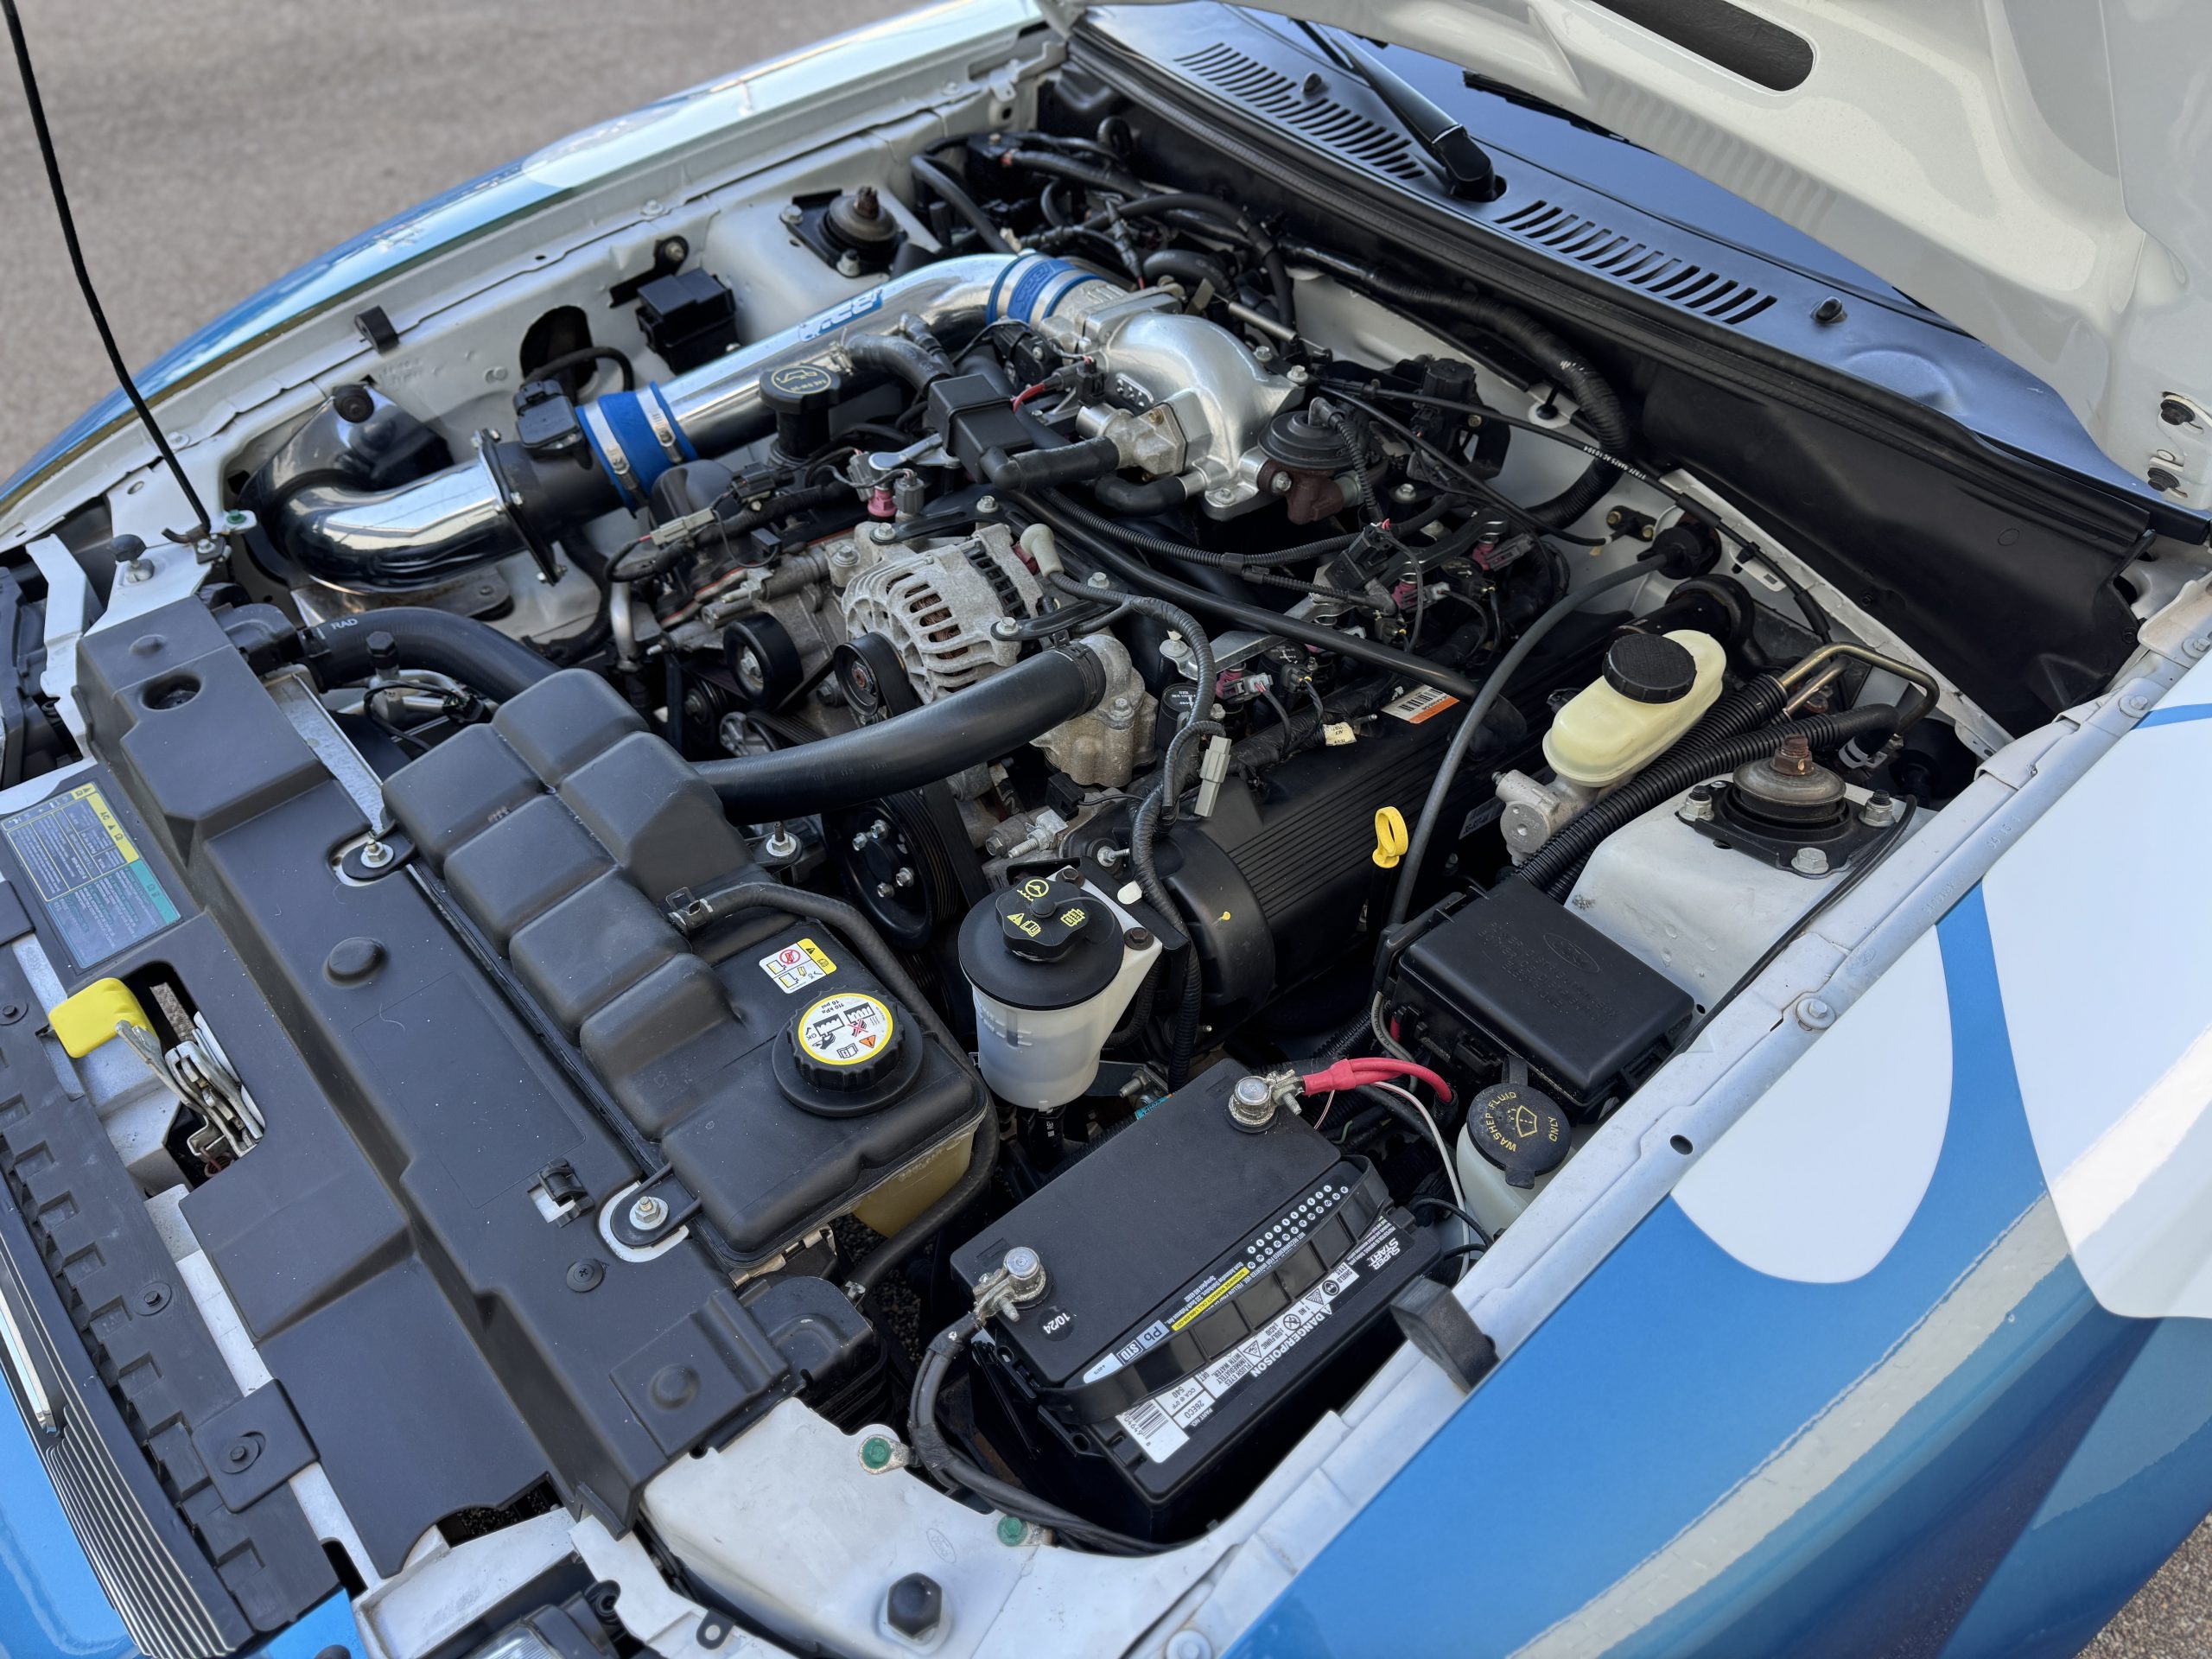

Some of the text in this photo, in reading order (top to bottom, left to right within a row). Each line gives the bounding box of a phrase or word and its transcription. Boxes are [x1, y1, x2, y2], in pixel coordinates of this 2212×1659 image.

[330, 617, 358, 629] RAD
[822, 1006, 834, 1014] kPa
[806, 1033, 817, 1041] OK
[1488, 1091, 1516, 1109] FLUID
[1548, 1116, 1559, 1142] ONLY
[1367, 1236, 1398, 1266] START
[1371, 1244, 1401, 1271] SUPER
[1223, 1269, 1245, 1289] NATIONWIDE
[1335, 1268, 1353, 1284] SHIELD
[1205, 1285, 1226, 1304] WARRANTY
[1197, 1300, 1208, 1310] CALL
[1297, 1306, 1307, 1316] NO
[1041, 1310, 1071, 1335] 10/24
[1263, 1323, 1277, 1336] ACID
[1141, 1325, 1162, 1344] Pb
[1259, 1329, 1283, 1351] SULFURIC
[1119, 1341, 1140, 1362] STD
[1249, 1311, 1325, 1378] DANGER/POISON
[1210, 1351, 1242, 1380] WITH WATER.
[1215, 1357, 1247, 1385] IMMEDIATELY
[1223, 1361, 1252, 1387] FLUSH EYES
[1197, 1370, 1210, 1382] GET
[1170, 1385, 1185, 1399] 540
[1182, 1386, 1196, 1399] CCA
[1189, 1407, 1213, 1428] PART NO.
